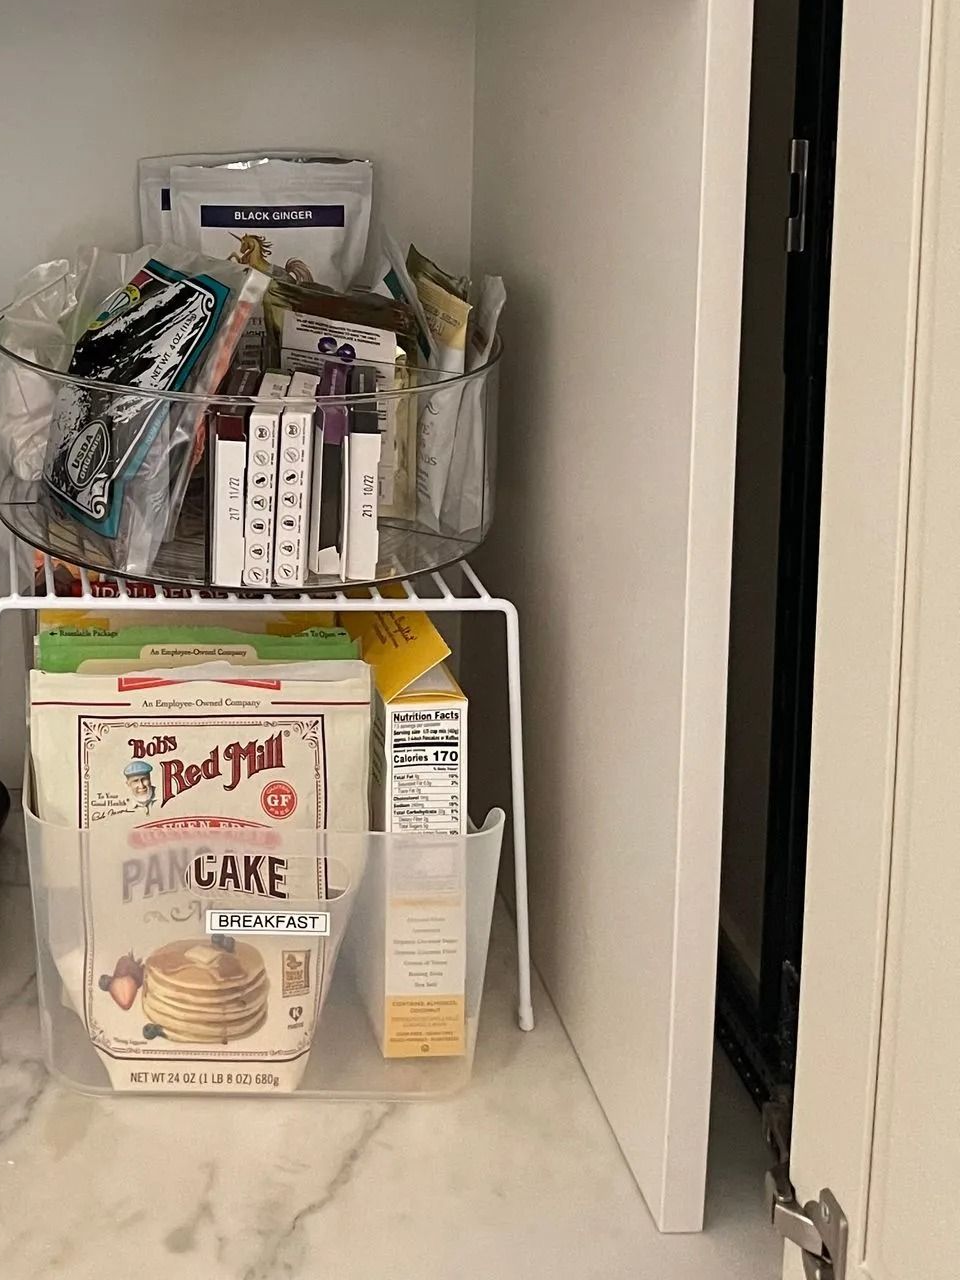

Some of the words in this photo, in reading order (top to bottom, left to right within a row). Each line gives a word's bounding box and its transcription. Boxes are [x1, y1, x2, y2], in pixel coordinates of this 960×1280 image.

[234, 211, 270, 221] BLACK
[272, 210, 313, 220] GINGER
[151, 367, 165, 381] NET
[160, 353, 172, 369] WT.
[170, 344, 176, 354] 4
[173, 332, 184, 346] OZ
[72, 434, 94, 468] USDA
[80, 434, 102, 480] ORGANIC
[229, 477, 240, 499] 11/22
[364, 474, 375, 496] 10/22
[229, 507, 240, 521] 217
[362, 504, 373, 518] 213
[92, 630, 119, 638] Package
[318, 631, 336, 639] Open
[161, 649, 216, 657] Employee-Owned
[155, 699, 223, 710] Employee-Owned
[225, 699, 261, 708] Company
[394, 713, 431, 722] Nutrition
[434, 711, 458, 720] Facts
[128, 735, 178, 760] Bob's
[394, 754, 428, 763] Calories
[433, 751, 458, 761] 170
[159, 745, 222, 808] Red
[223, 730, 286, 791] Mill
[267, 794, 292, 807] GF
[218, 915, 320, 929] BREAKFAST
[130, 1073, 149, 1084] NET
[151, 1072, 166, 1083] WT
[168, 1072, 180, 1083] 24
[183, 1072, 196, 1083] OZ
[199, 1072, 208, 1085] (1
[212, 1072, 224, 1083] LB
[227, 1072, 233, 1083] 8
[236, 1072, 252, 1085] OZ)
[255, 1072, 280, 1086] 680g
